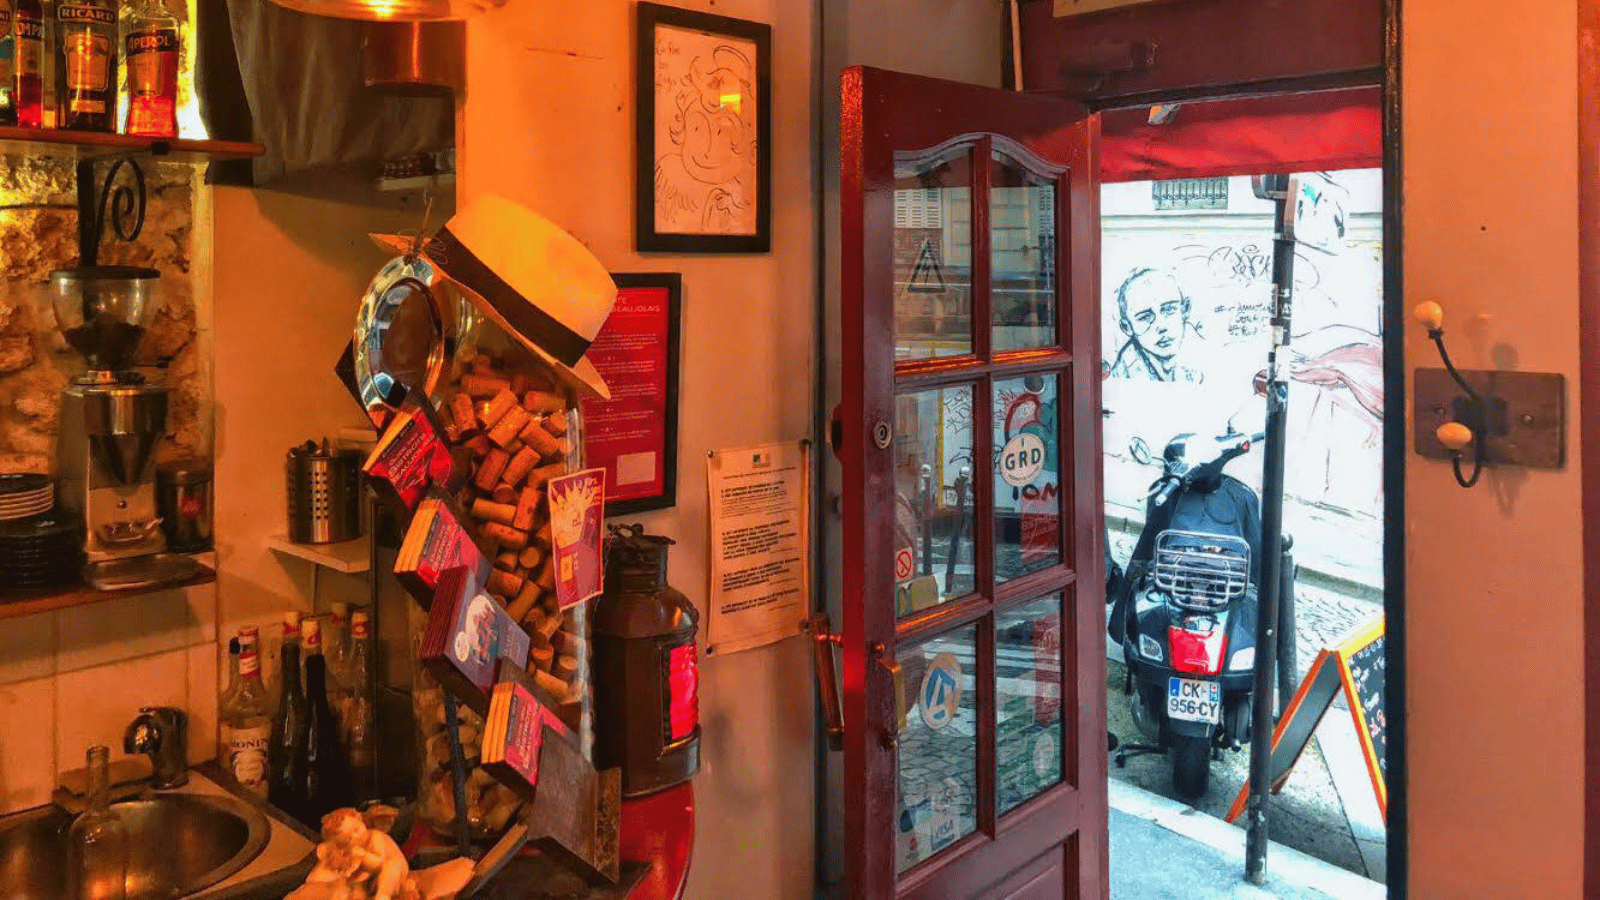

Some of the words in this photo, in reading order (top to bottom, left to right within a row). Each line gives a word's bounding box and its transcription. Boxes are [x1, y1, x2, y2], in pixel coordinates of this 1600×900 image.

[61, 9, 114, 21] RICARD
[128, 34, 173, 50] APEROL
[1005, 447, 1042, 470] GRD
[1170, 698, 1218, 717] 956-CY
